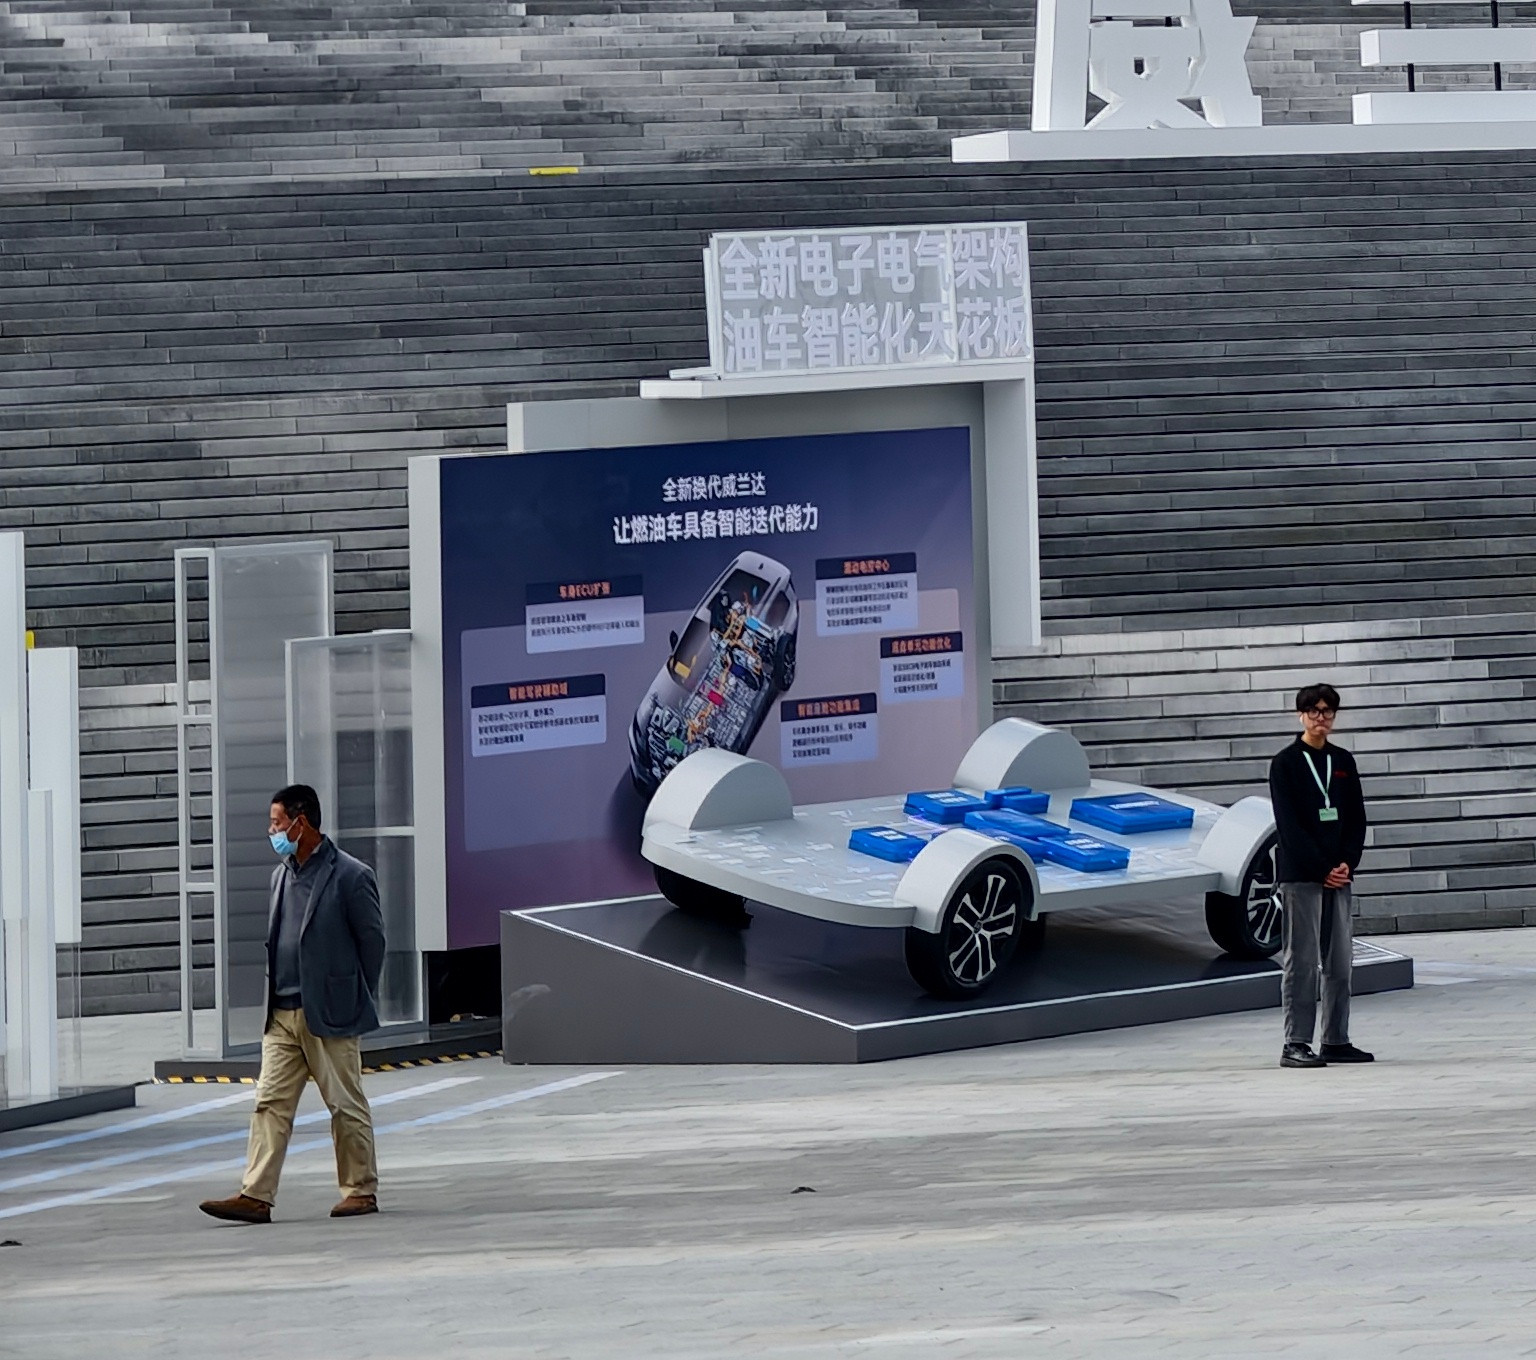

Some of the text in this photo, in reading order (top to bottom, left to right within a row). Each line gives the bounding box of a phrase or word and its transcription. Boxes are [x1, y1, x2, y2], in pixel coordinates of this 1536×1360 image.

[719, 227, 1024, 301] 全新电子电气架构
[722, 294, 1030, 374] 油车智能化天花板
[661, 470, 767, 503] 全新换代威兰达
[612, 501, 819, 545] 让燃油车具备智能迭代能力
